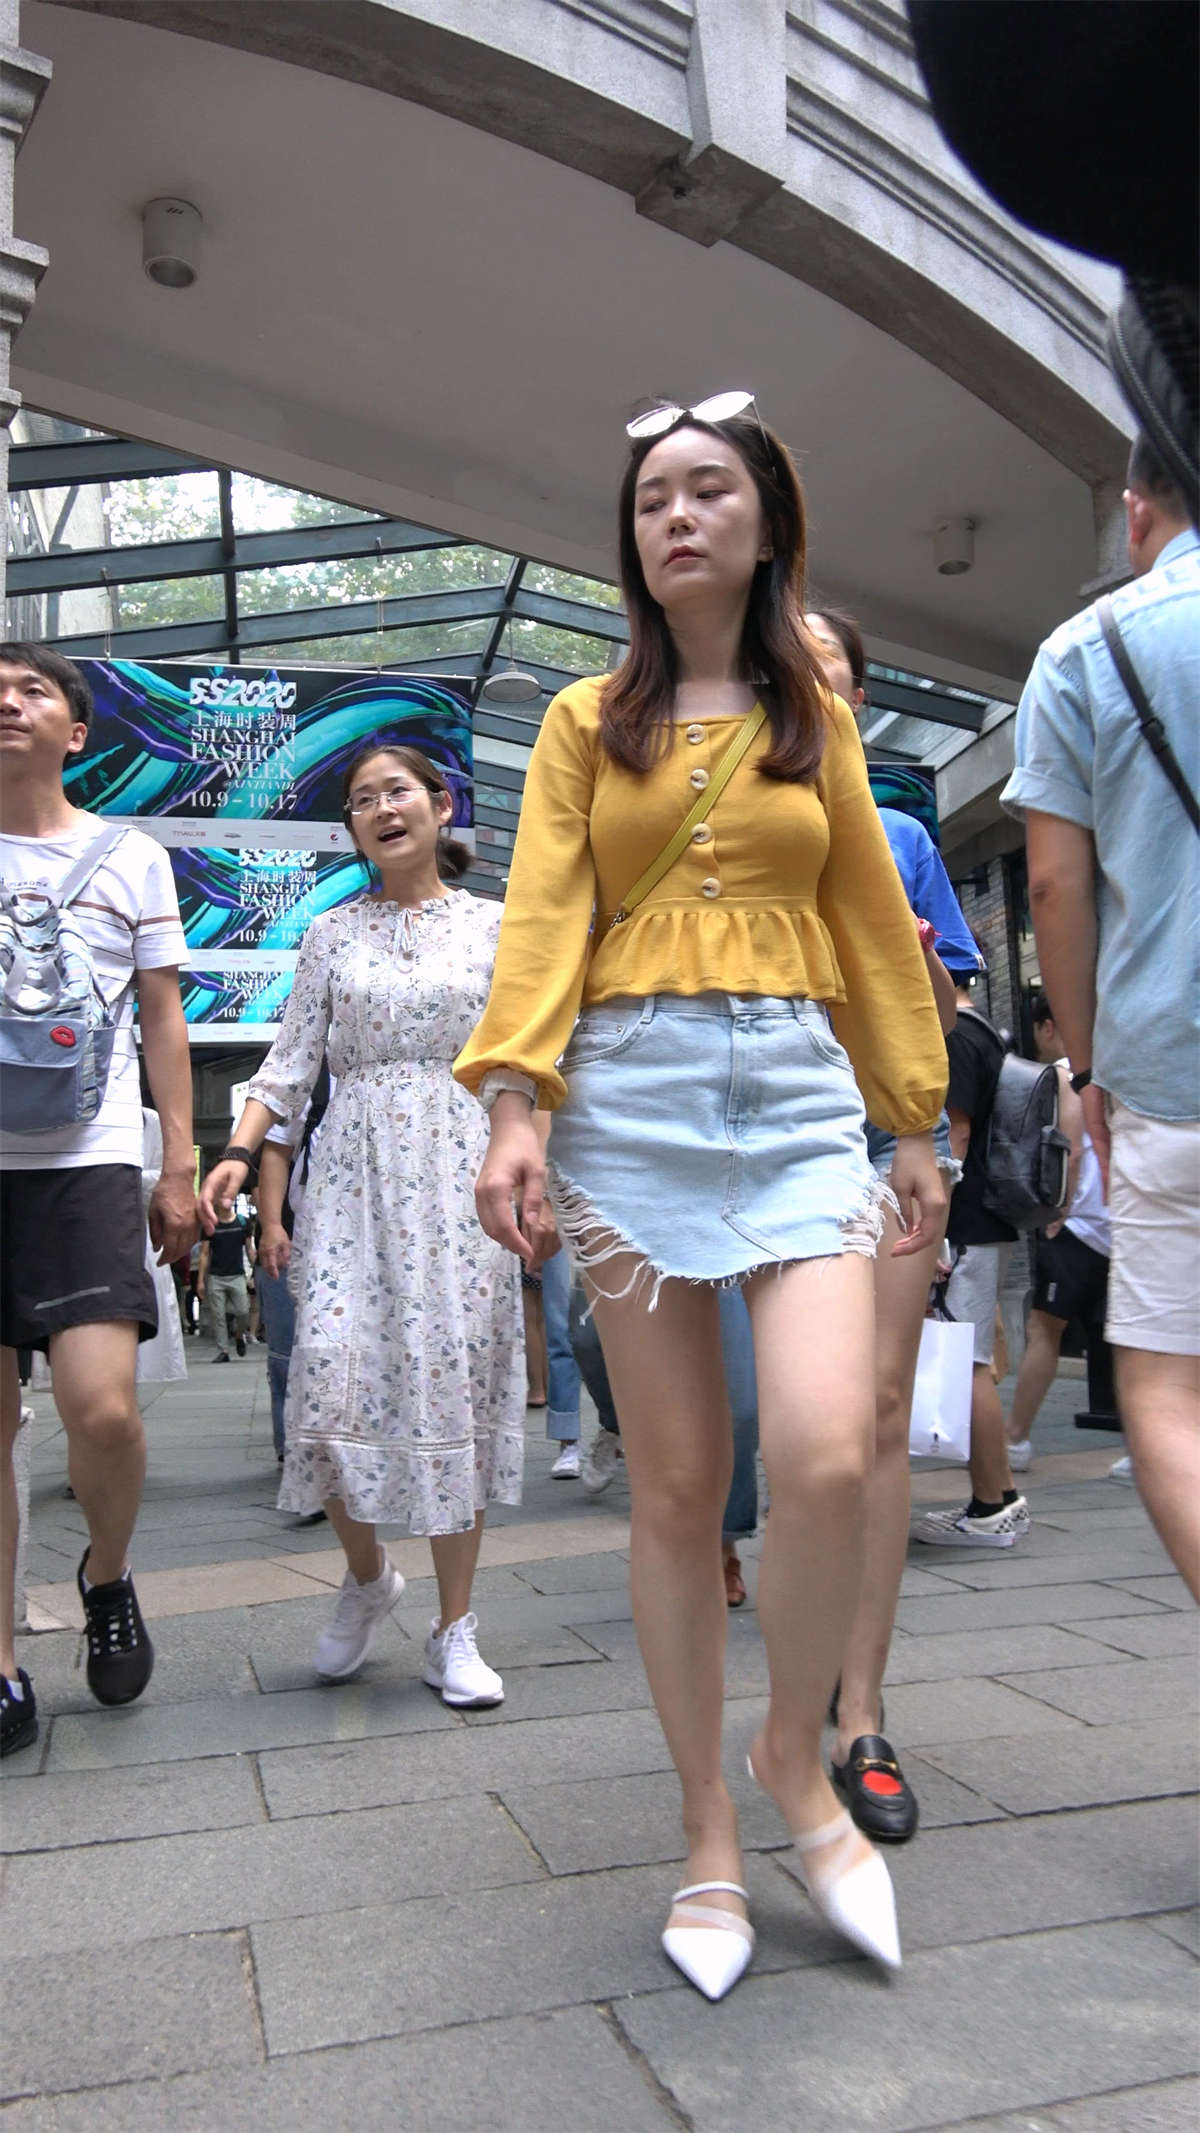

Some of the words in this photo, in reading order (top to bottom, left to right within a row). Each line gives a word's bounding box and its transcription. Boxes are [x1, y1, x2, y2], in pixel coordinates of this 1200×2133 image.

[189, 678, 297, 709] SS2020
[191, 709, 297, 731] 上海时装周
[191, 728, 296, 745] SHANGHAI
[192, 743, 296, 762] FASHION
[222, 760, 296, 780] WEEK
[190, 791, 229, 808] 10.9
[249, 792, 298, 811] 10.17
[238, 848, 317, 868] SS2020
[240, 882, 316, 895] SHANGHAI
[240, 893, 315, 908] FASHION
